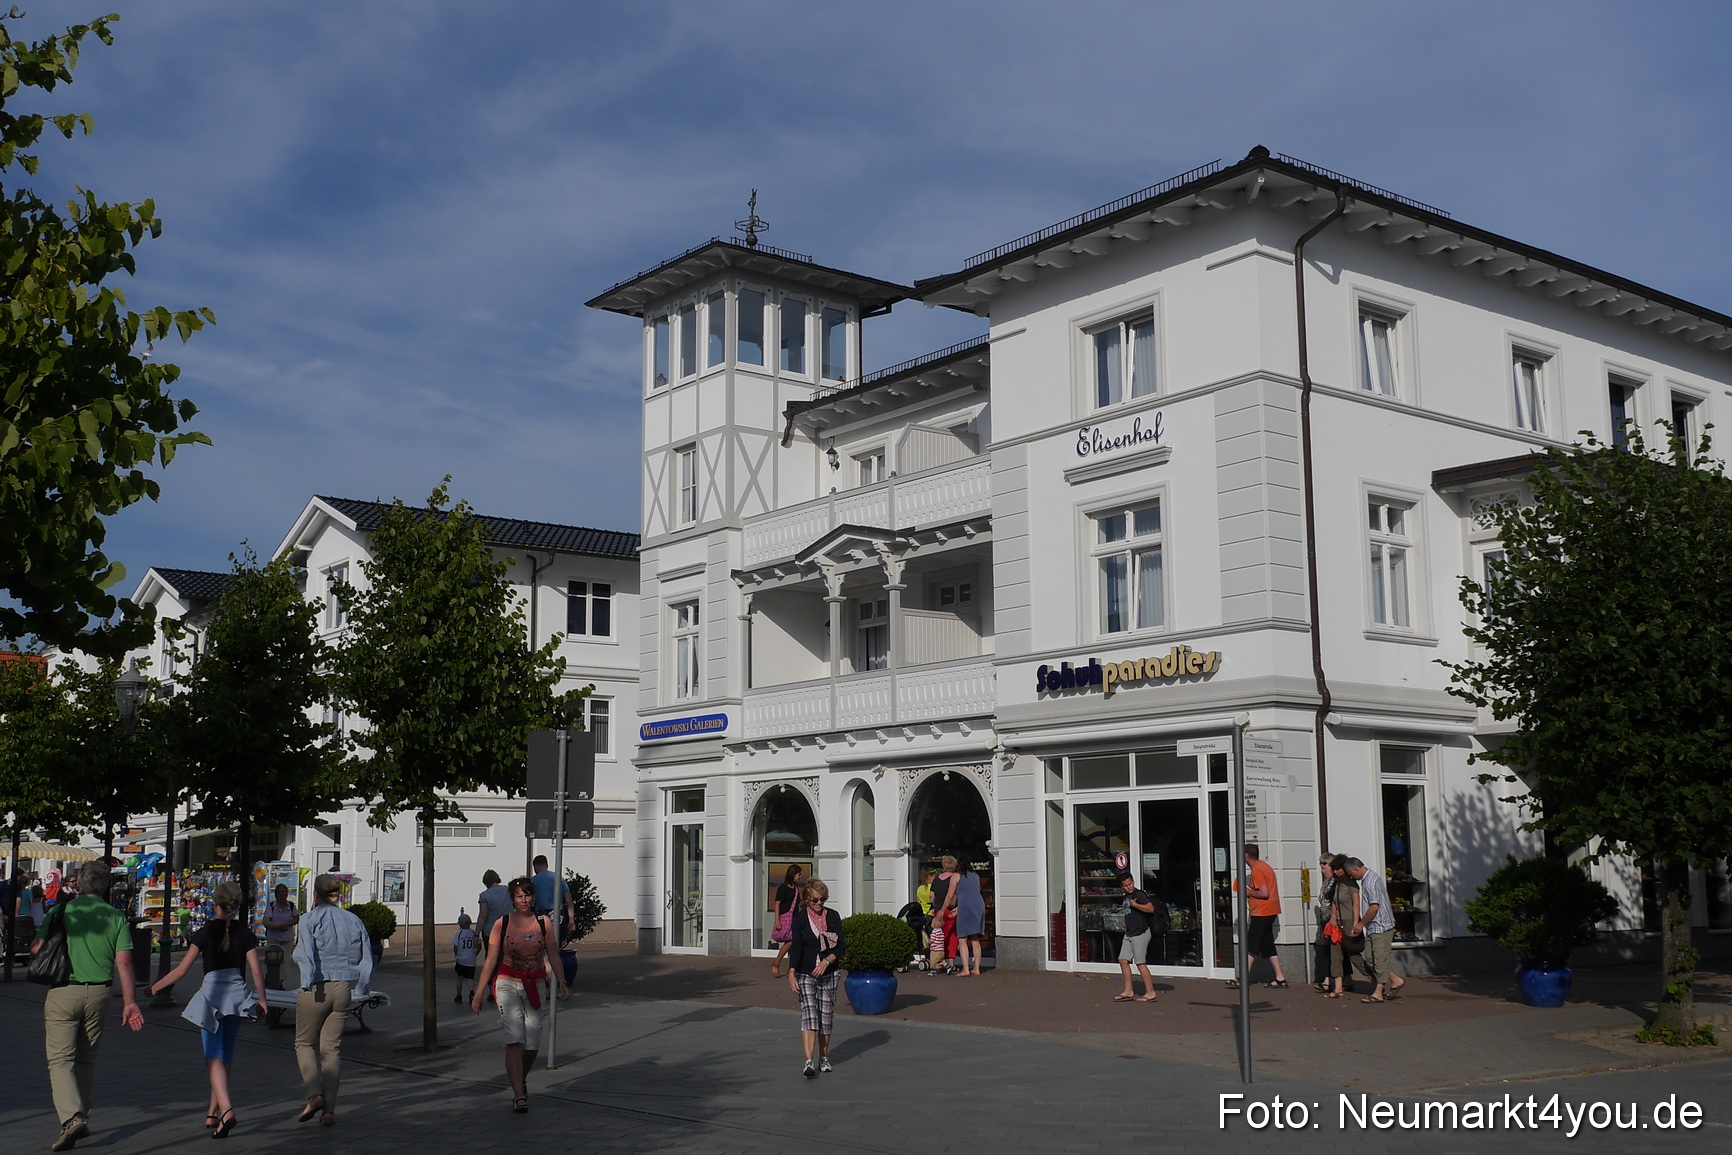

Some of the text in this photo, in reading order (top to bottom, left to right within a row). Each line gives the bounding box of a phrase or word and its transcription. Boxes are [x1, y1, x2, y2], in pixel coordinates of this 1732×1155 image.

[1076, 411, 1165, 457] Elisenhof
[1036, 644, 1219, 693] Schuhparadies
[462, 939, 473, 949] 10
